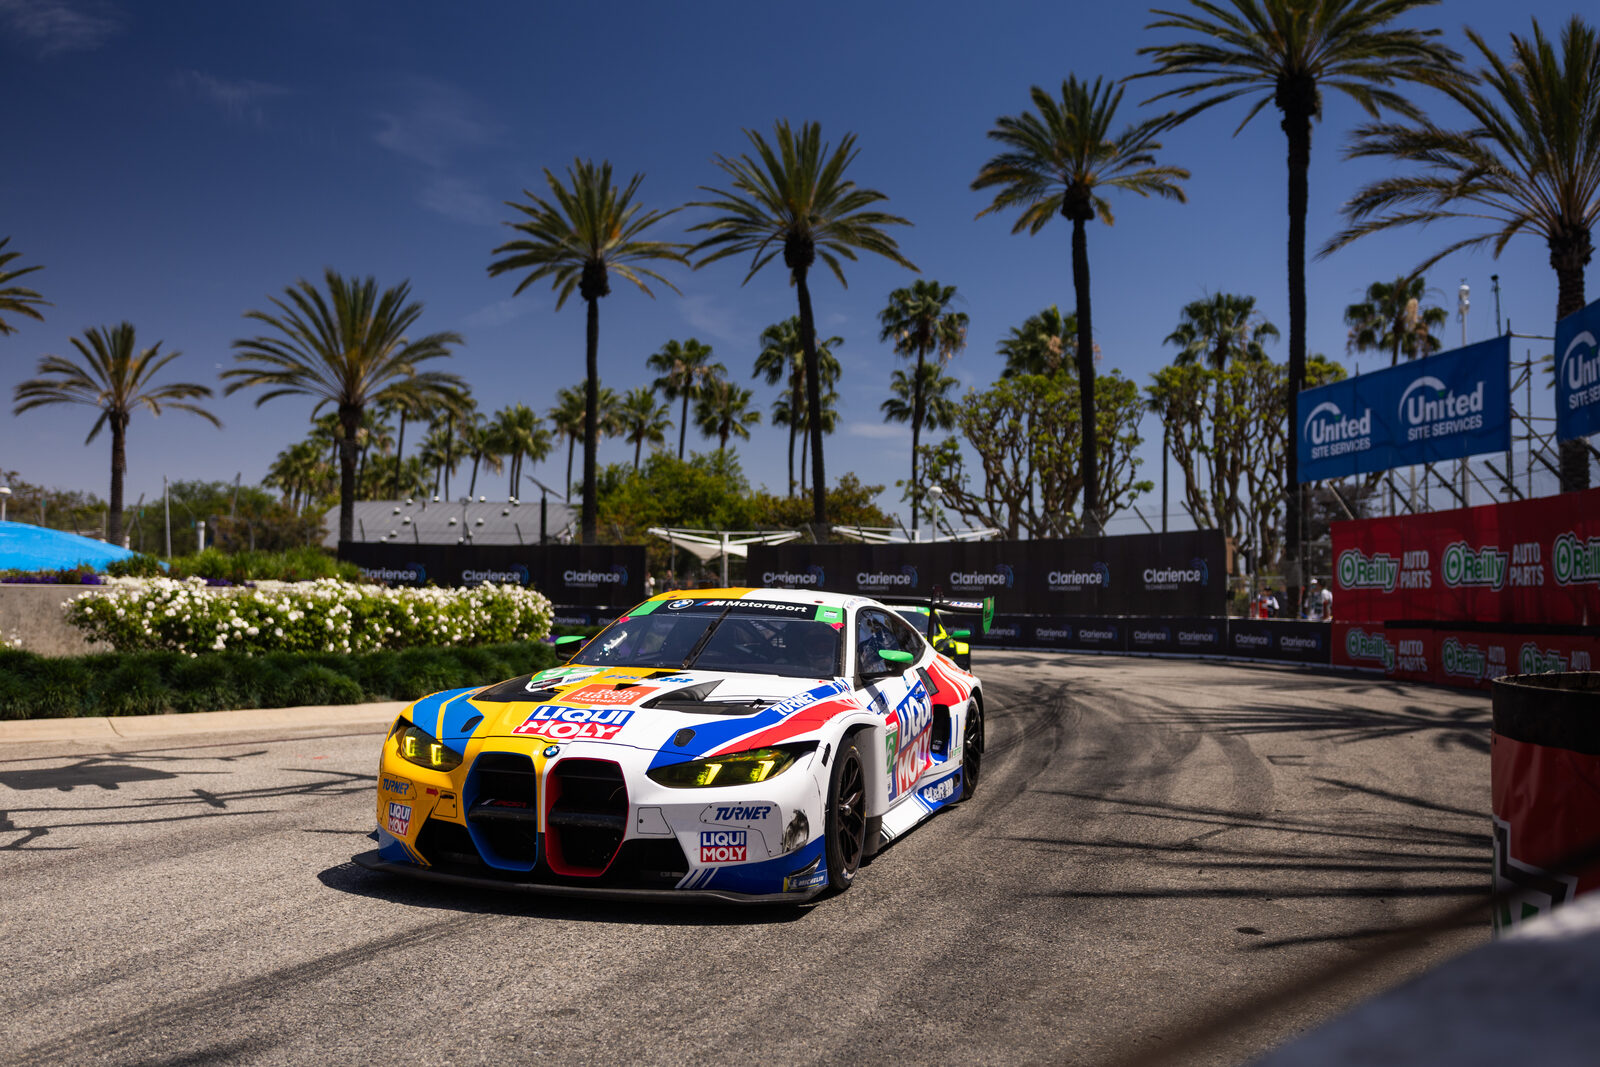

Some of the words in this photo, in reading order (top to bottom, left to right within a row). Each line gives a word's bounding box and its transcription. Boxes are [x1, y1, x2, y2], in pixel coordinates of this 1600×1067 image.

[1569, 350, 1600, 390] Uni
[1407, 381, 1484, 425] United
[1569, 393, 1589, 409] SITE
[1311, 408, 1371, 445] United
[1408, 426, 1430, 441] SITE
[1432, 415, 1483, 437] SERVICES
[1311, 446, 1329, 459] SITE
[1330, 438, 1371, 456] SERVICES
[1403, 550, 1429, 569] AUTO
[1512, 542, 1541, 565] AUTO
[1554, 535, 1600, 582] O'Reill
[1339, 549, 1398, 591] O'Reilly
[1444, 542, 1507, 590] O'Reilly
[462, 569, 520, 582] Clarience
[563, 569, 620, 583] Clarience
[857, 571, 911, 585] Clarience
[950, 571, 1006, 585] Clarience
[1048, 570, 1102, 585] Clarience
[1144, 567, 1201, 583] Clarience
[1401, 570, 1432, 589] PARTS
[1509, 566, 1544, 586] PARTS
[725, 601, 808, 613] Motorsport
[1079, 630, 1113, 639] Clarience
[1134, 630, 1166, 640] Clarience
[1178, 631, 1214, 642] Clarience
[1235, 633, 1269, 645] Clarience
[1280, 636, 1317, 648] Clarience
[1399, 640, 1423, 655] AUTO
[771, 691, 818, 716] TURNER
[533, 706, 631, 724] LIQUI
[899, 694, 932, 749] LIQUI
[518, 720, 618, 738] MOLY
[383, 778, 409, 795] TURNER
[390, 803, 411, 821] LIQUI
[714, 806, 771, 821] TURNER
[389, 817, 408, 834] MOLY
[703, 832, 745, 847] LIQUI
[702, 847, 746, 861] MOLY
